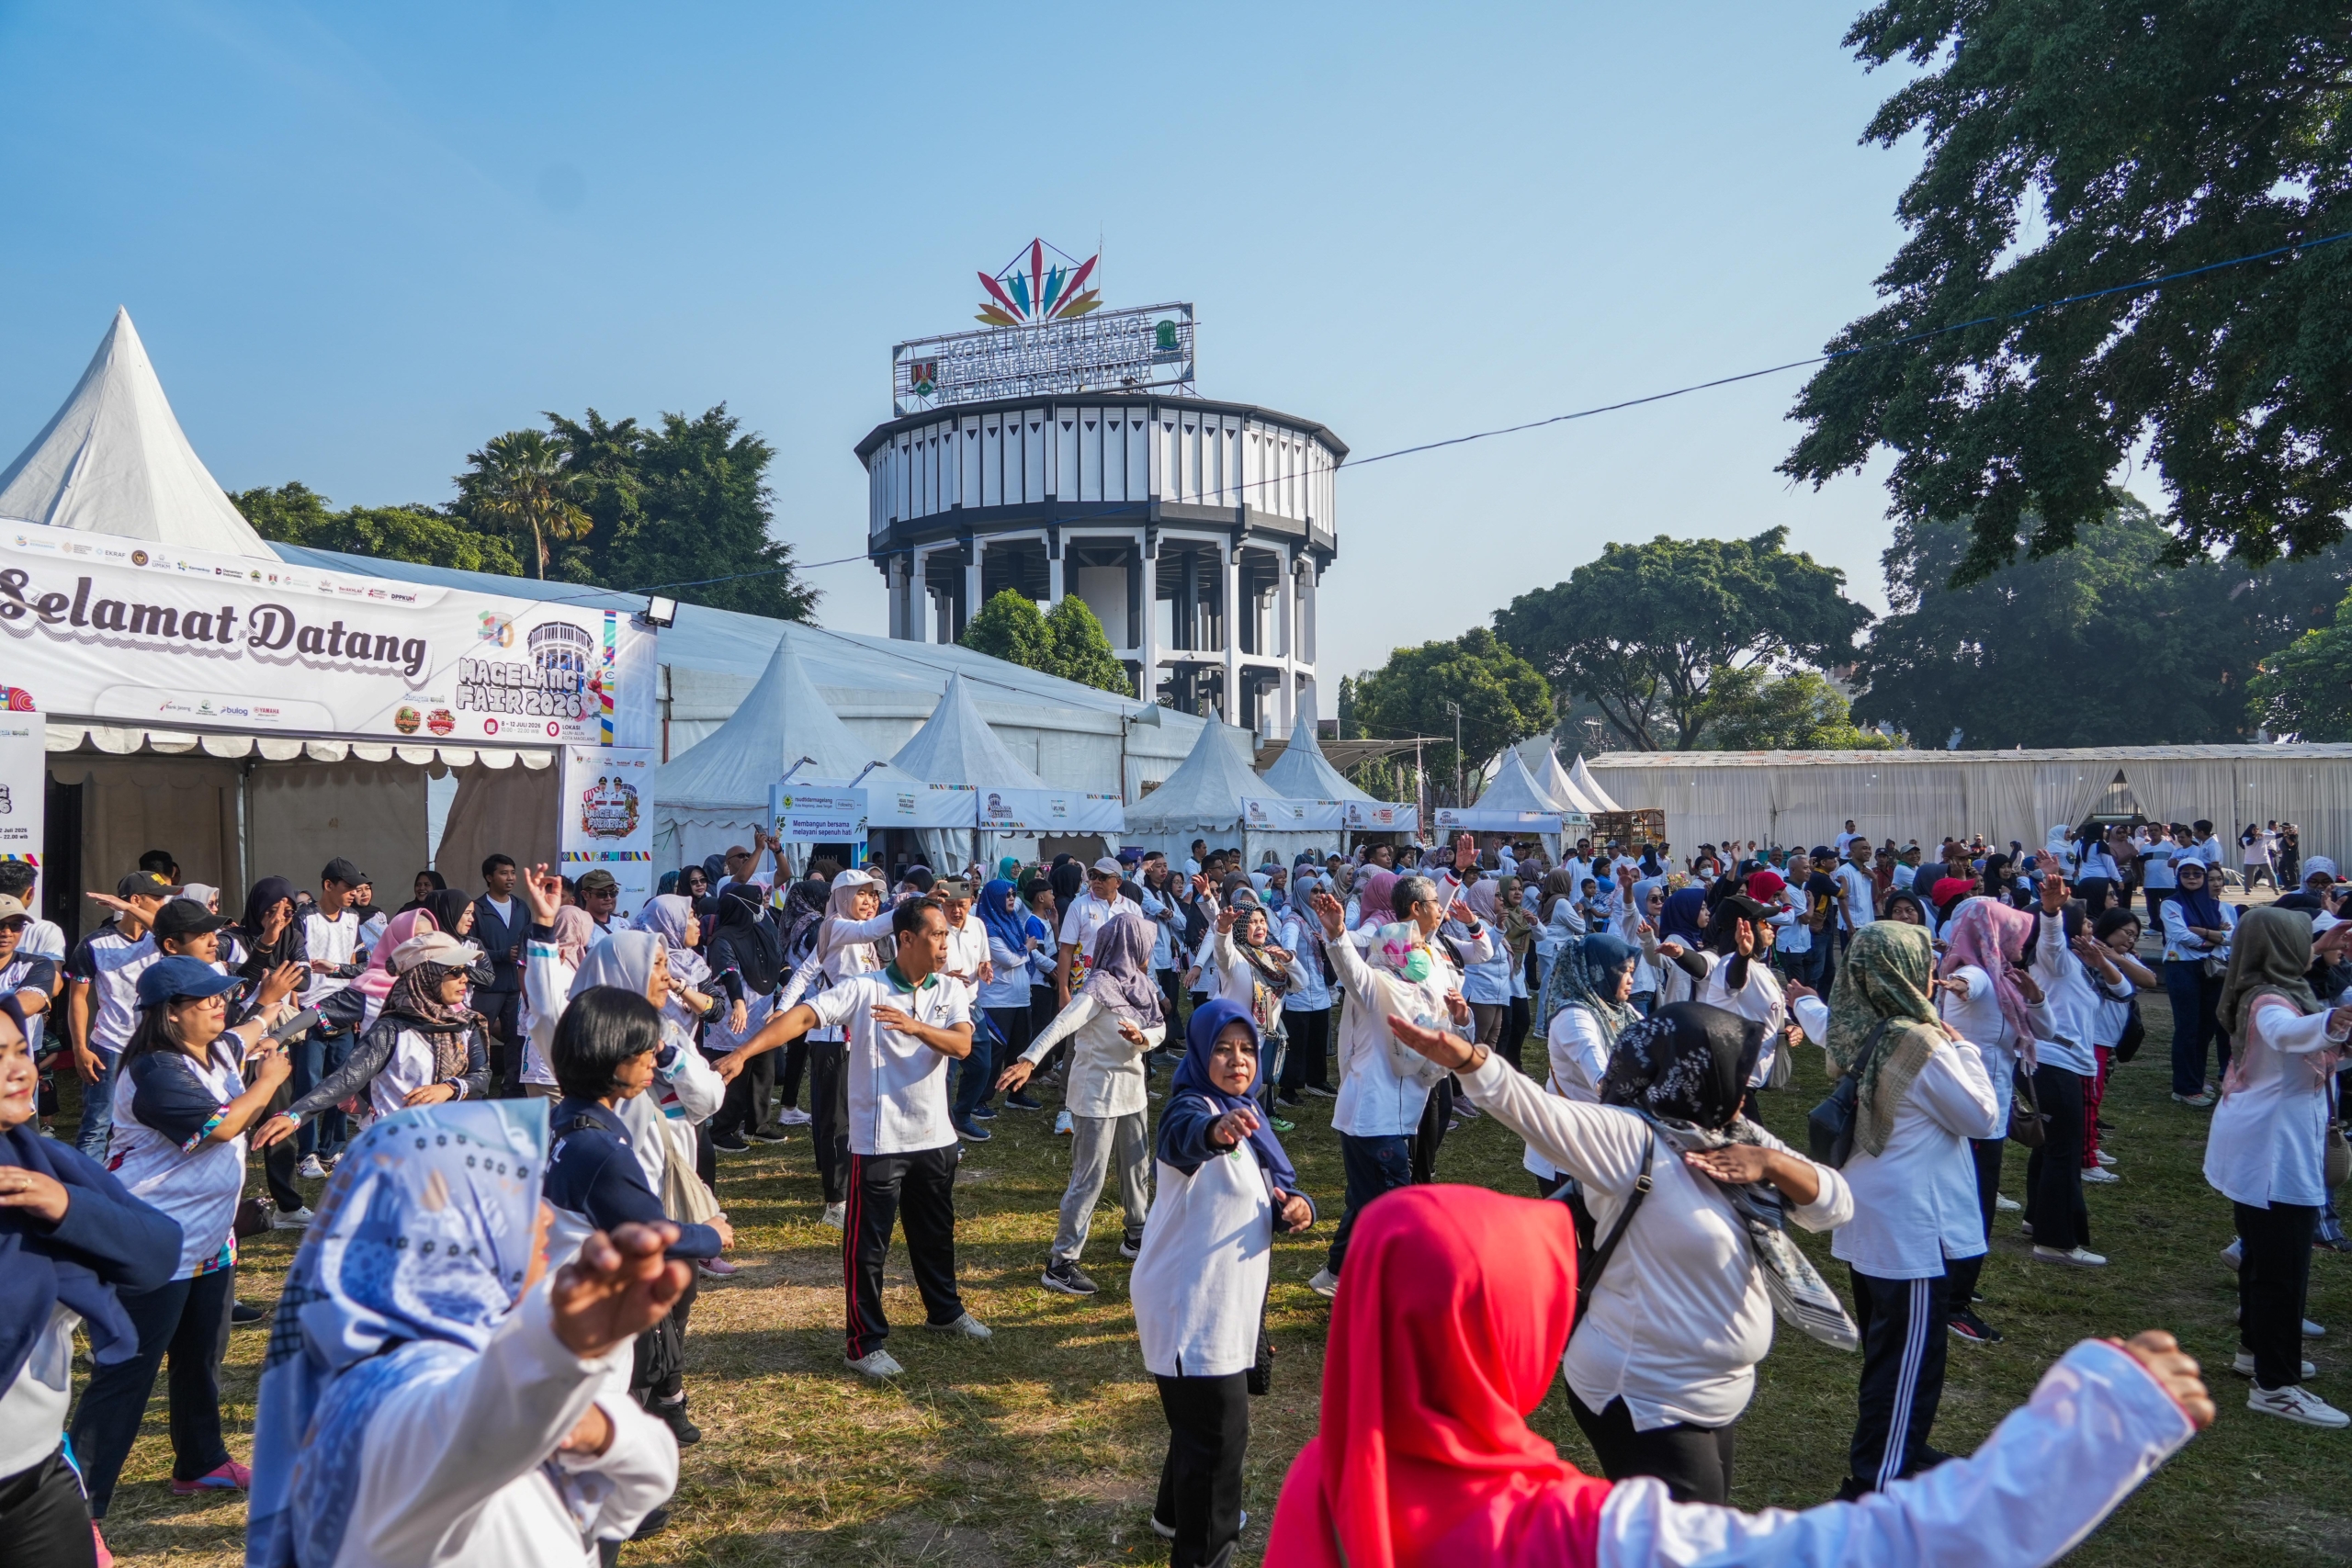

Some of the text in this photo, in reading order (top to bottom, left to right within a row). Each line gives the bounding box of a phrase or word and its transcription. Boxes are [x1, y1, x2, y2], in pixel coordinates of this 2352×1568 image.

[947, 317, 1141, 364] KOTA MAGELANG
[938, 341, 1148, 384] MEMBANGUN BERSAMA
[936, 361, 1153, 404] MELAYANI SEPENUH HATI
[105, 550, 126, 558] EKRAF
[152, 561, 171, 570] UMKM
[390, 593, 416, 602] DPPKUM
[0, 569, 426, 677] Selamat Datang
[459, 658, 578, 691] MAGELANG
[457, 684, 582, 717] FAIR 2026
[226, 706, 248, 716] bulog
[795, 796, 832, 805] rsudtidarmagelang
[588, 809, 629, 819] MAGELANG
[588, 819, 628, 829] FAIR 2026
[793, 819, 826, 829] Membangun
[793, 828, 818, 837] melayani
[819, 829, 842, 837] sepenuh
